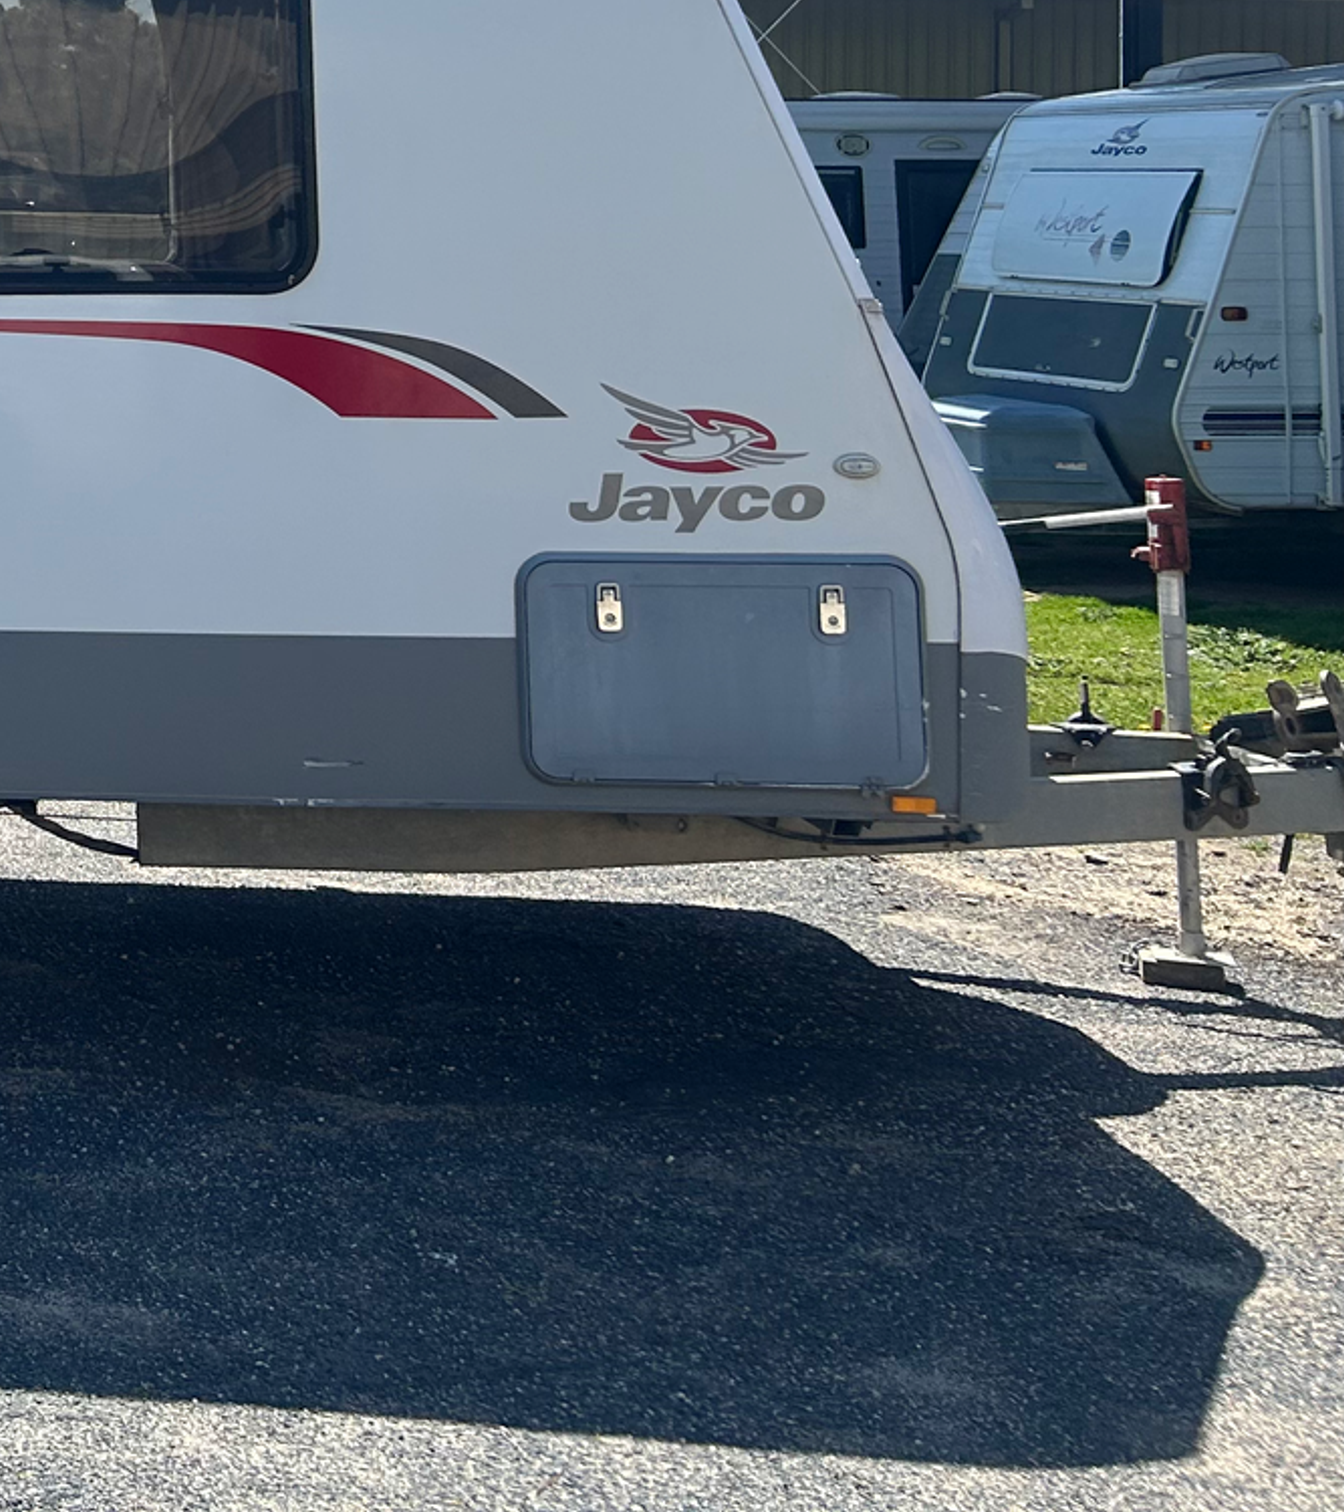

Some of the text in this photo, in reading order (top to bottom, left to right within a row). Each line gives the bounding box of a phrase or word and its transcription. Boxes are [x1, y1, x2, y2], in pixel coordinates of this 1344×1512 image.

[1090, 143, 1148, 157] Jayco
[1213, 348, 1280, 379] Westport
[569, 472, 826, 534] Jayco
